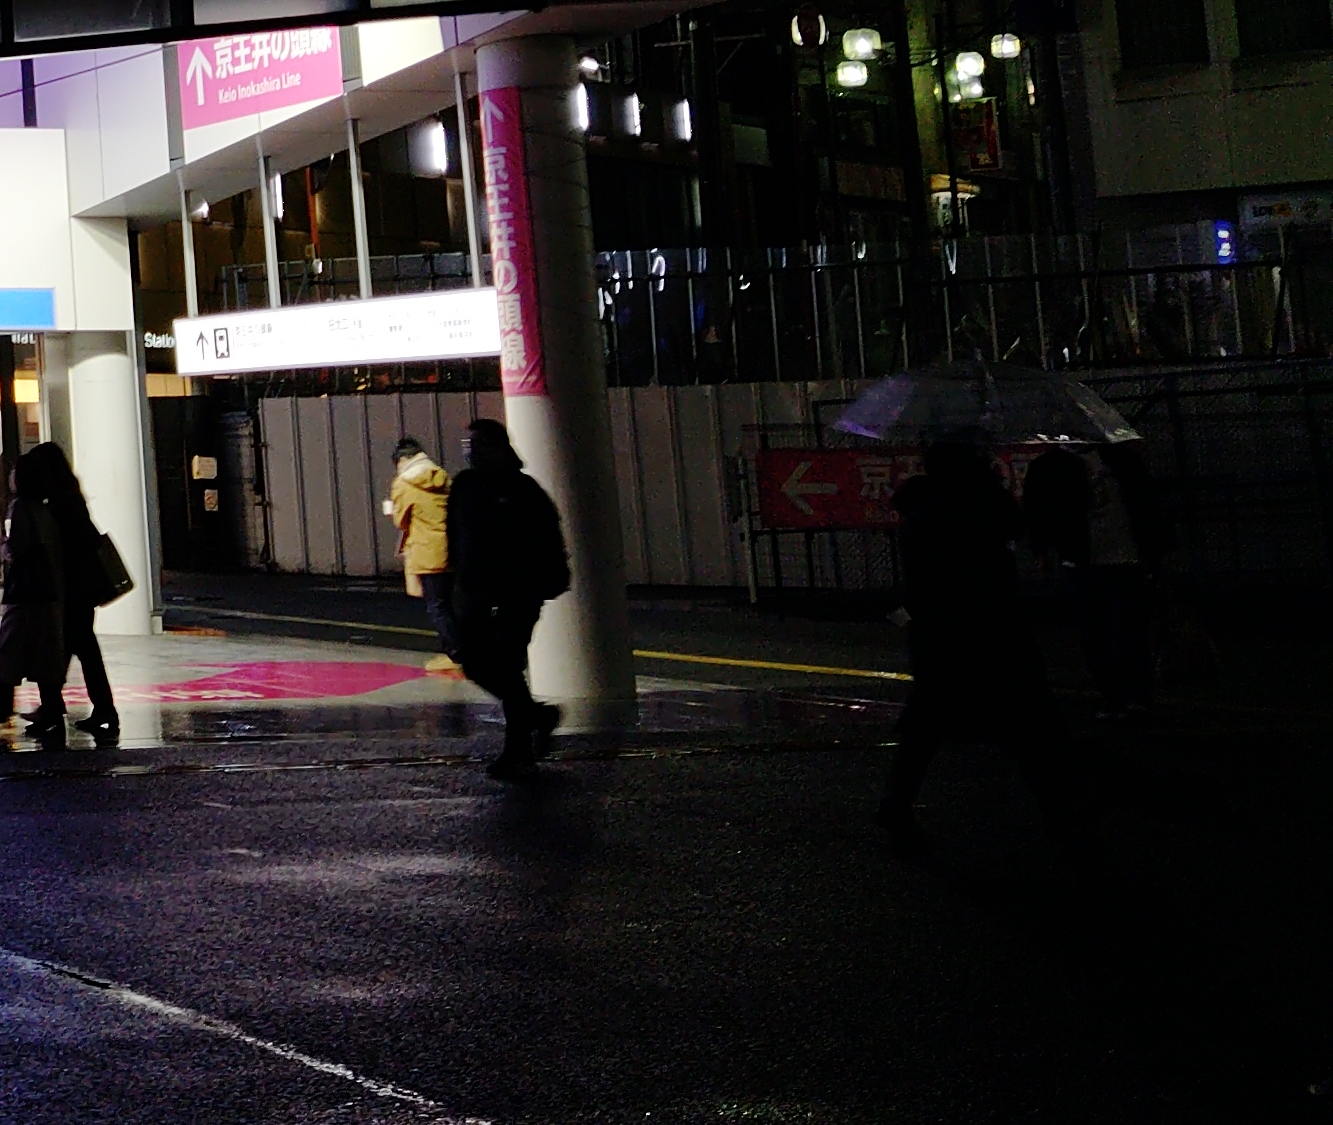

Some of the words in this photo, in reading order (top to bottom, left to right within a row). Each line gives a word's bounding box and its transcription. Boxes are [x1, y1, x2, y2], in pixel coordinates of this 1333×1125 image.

[218, 87, 237, 105] Keio
[238, 77, 281, 99] Inokashira
[282, 71, 301, 89] Line
[143, 332, 175, 349] Statio
